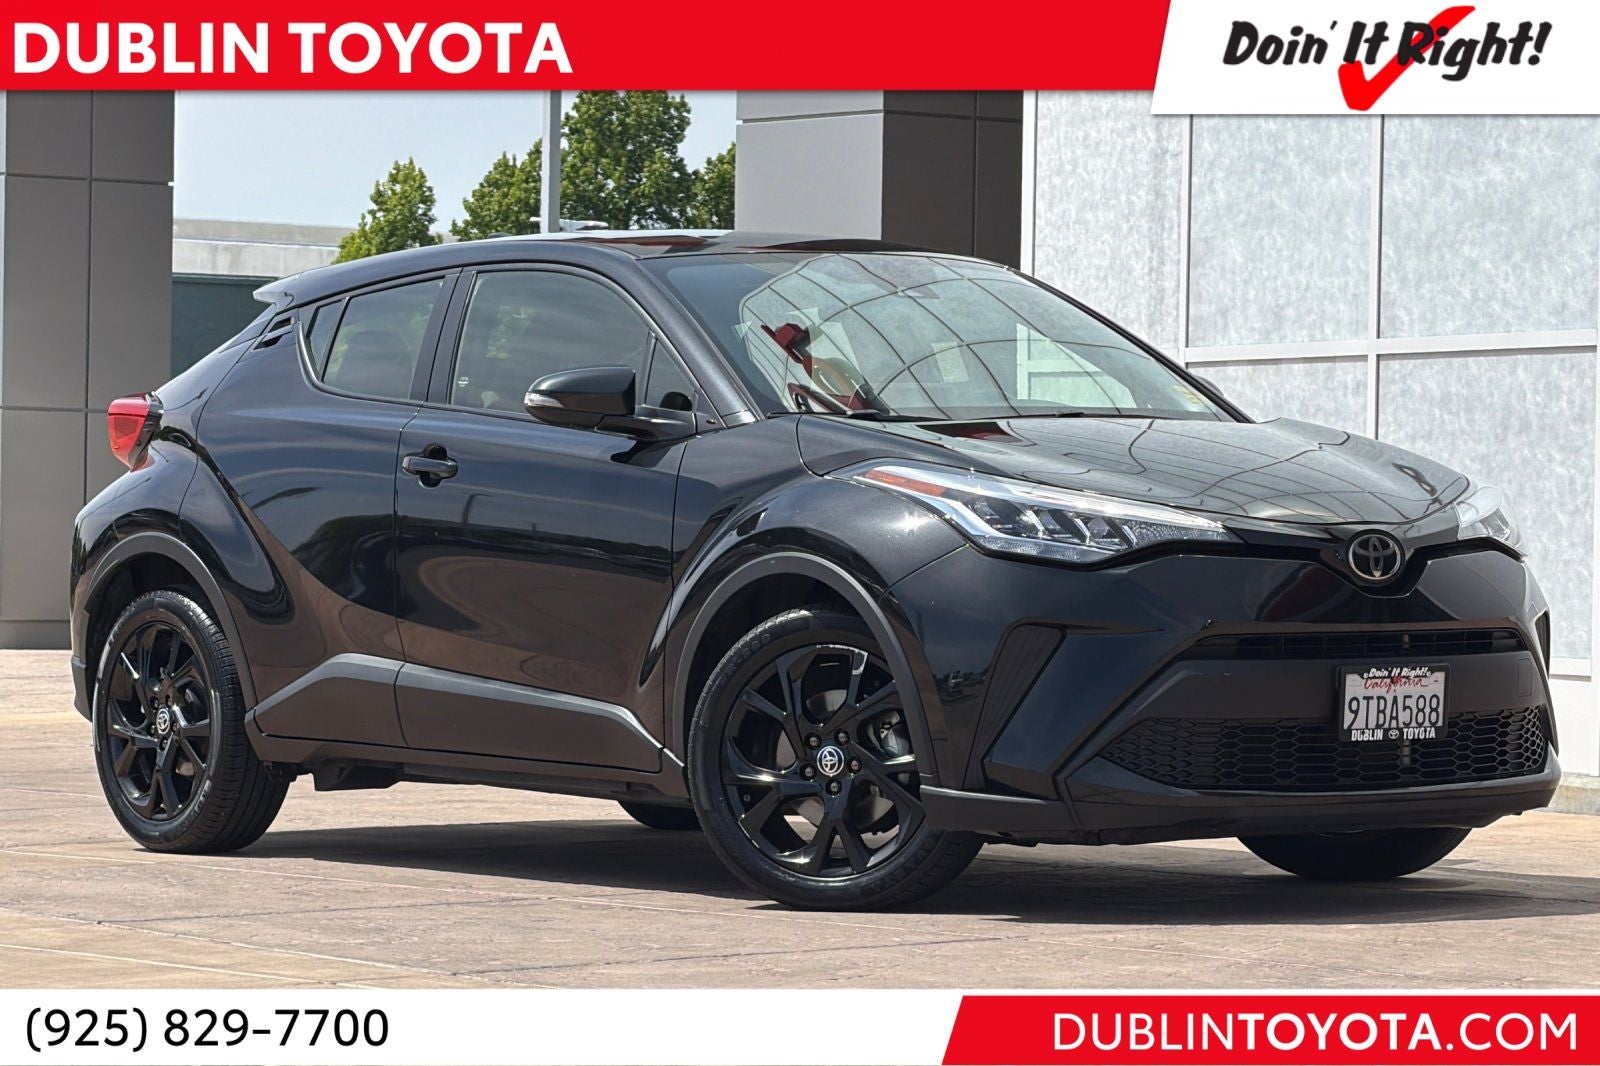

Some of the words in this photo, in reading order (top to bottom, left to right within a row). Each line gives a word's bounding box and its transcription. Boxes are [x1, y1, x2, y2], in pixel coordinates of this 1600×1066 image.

[1391, 667, 1401, 677] It
[1401, 666, 1429, 679] Right!
[1347, 694, 1440, 729] 9TBA588
[1351, 728, 1384, 741] DUBLIN
[1402, 726, 1436, 739] TOYOTA
